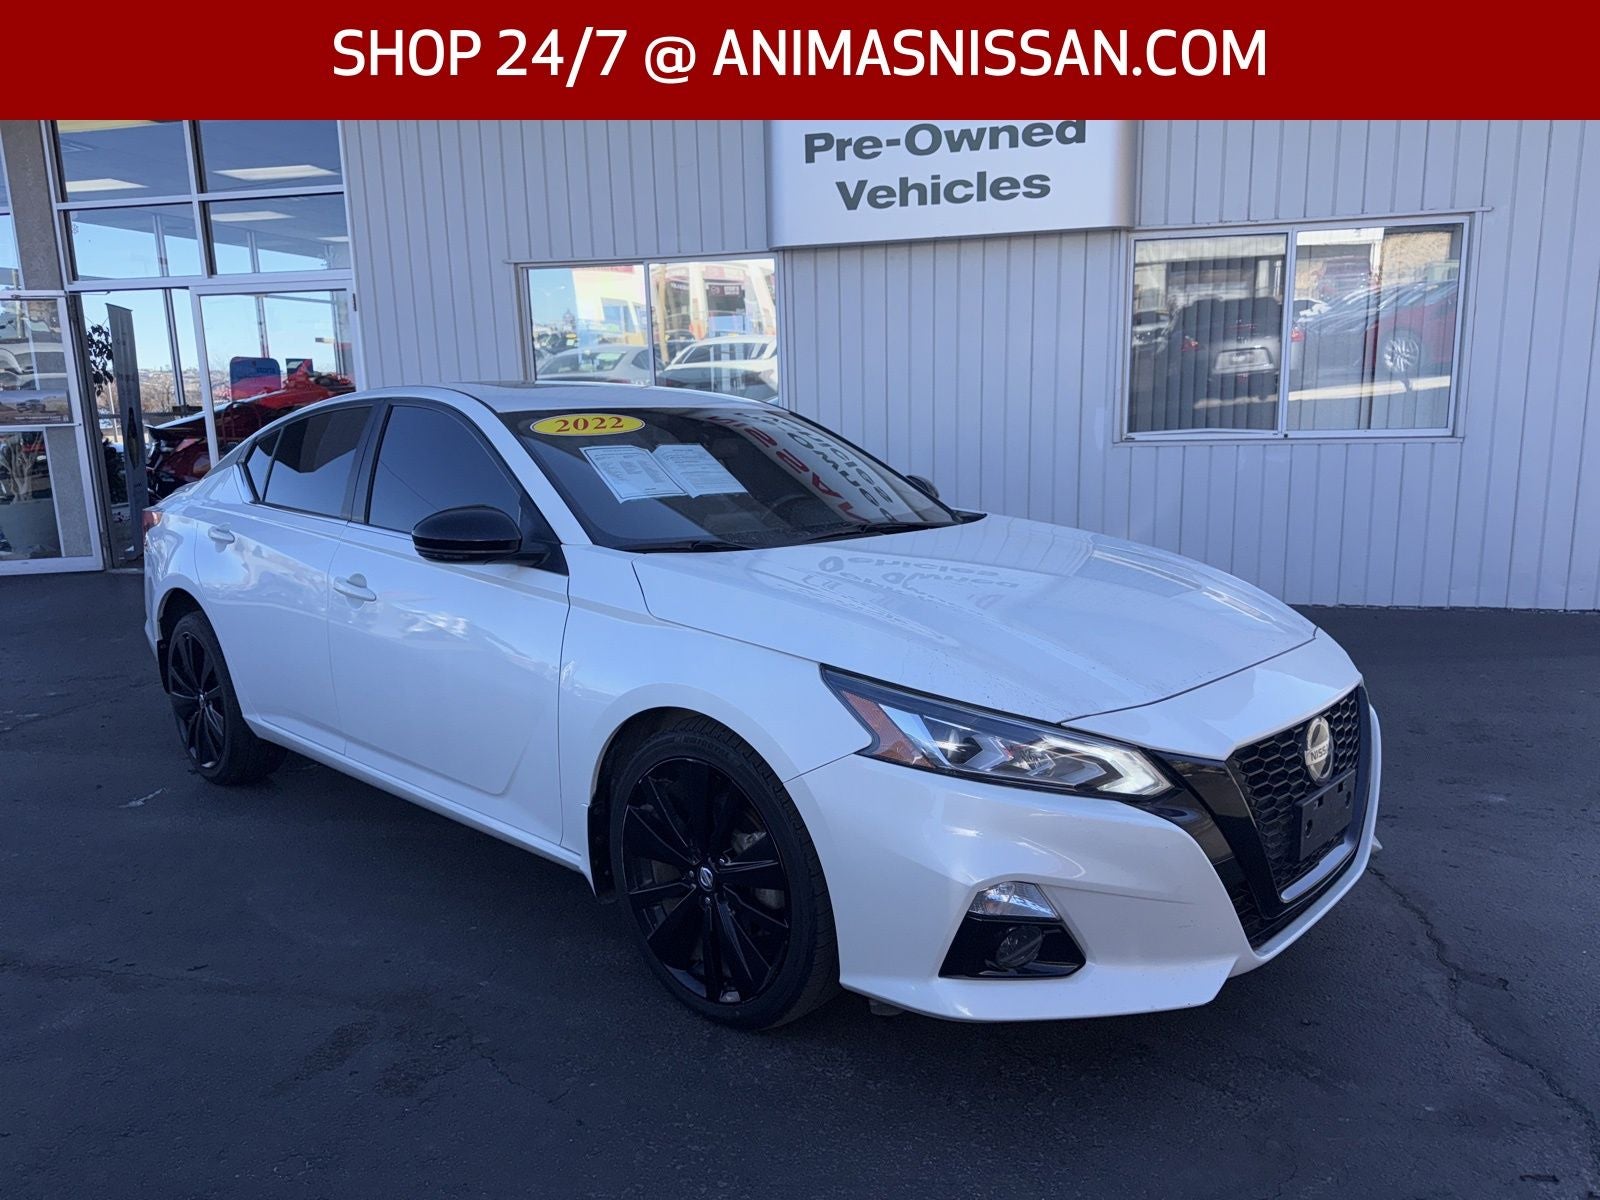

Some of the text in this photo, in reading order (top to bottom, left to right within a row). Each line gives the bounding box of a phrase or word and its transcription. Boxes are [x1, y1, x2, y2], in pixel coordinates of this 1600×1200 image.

[804, 119, 1087, 164] Pre-Owned
[836, 172, 1051, 211] Vehicles
[554, 416, 624, 433] 2022
[1310, 743, 1328, 762] NISS
